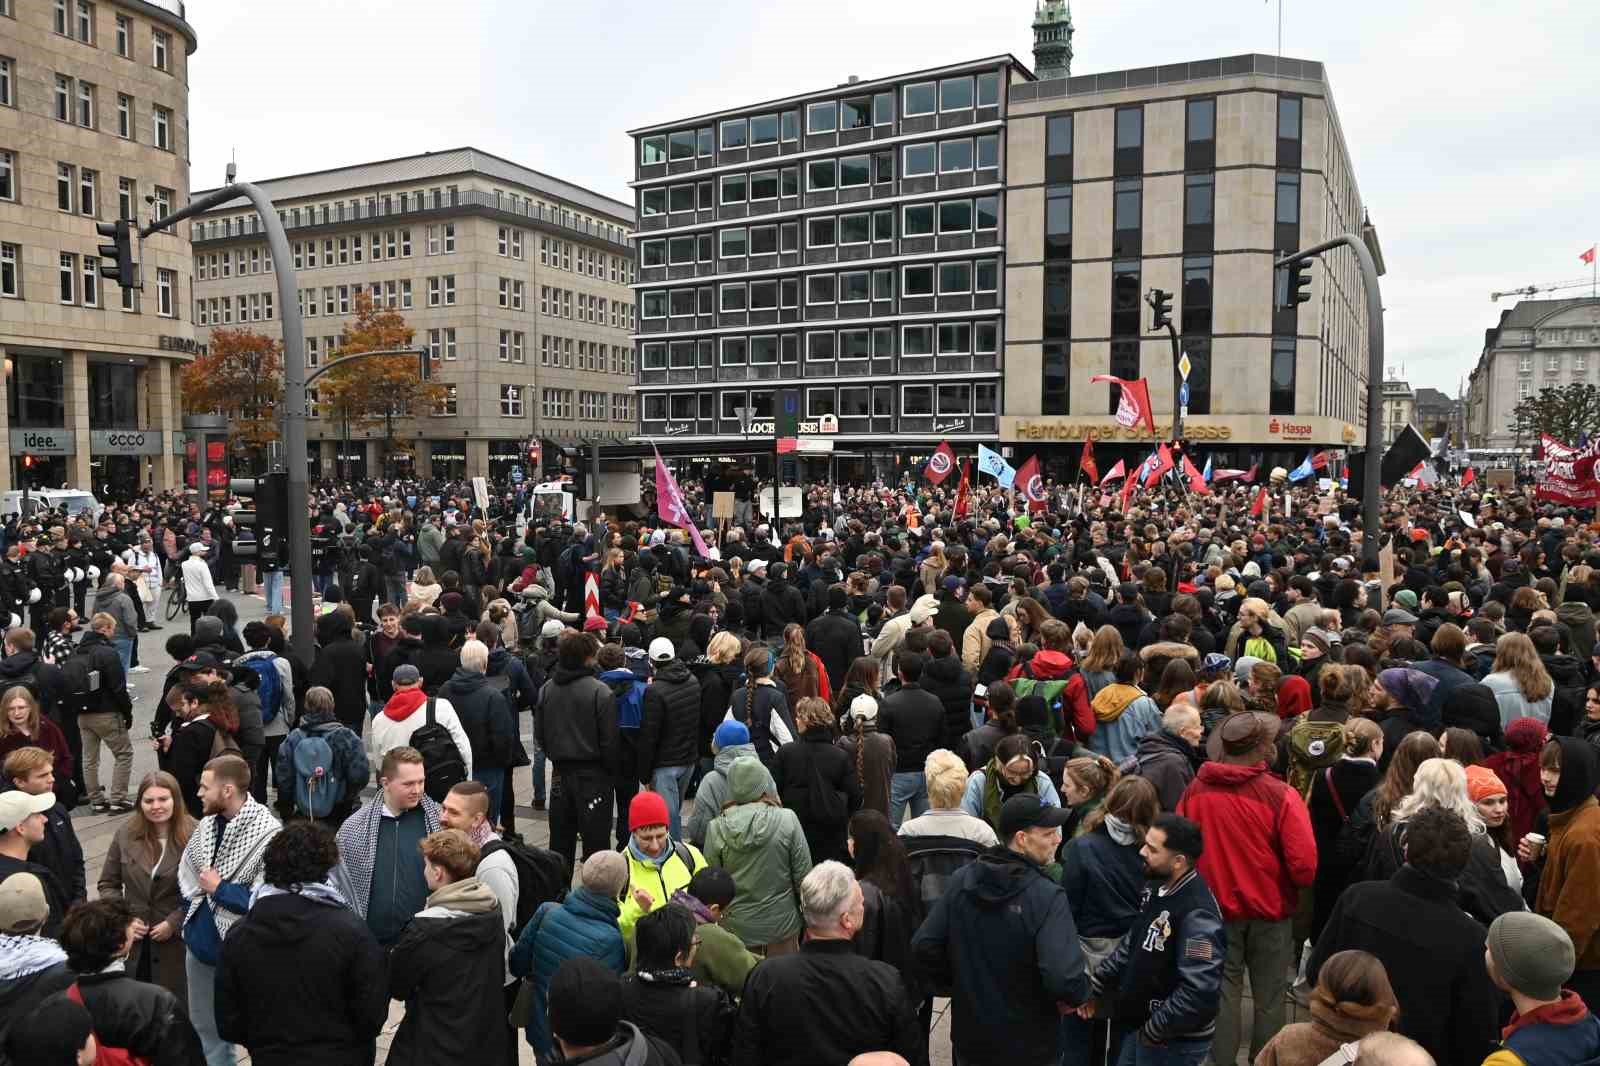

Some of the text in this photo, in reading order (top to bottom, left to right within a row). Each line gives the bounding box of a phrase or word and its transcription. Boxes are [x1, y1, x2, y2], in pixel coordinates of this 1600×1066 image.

[1016, 420, 1121, 441] Hamburger
[1282, 423, 1312, 436] Haspa
[24, 433, 57, 448] idee.
[109, 434, 145, 447] ecco
